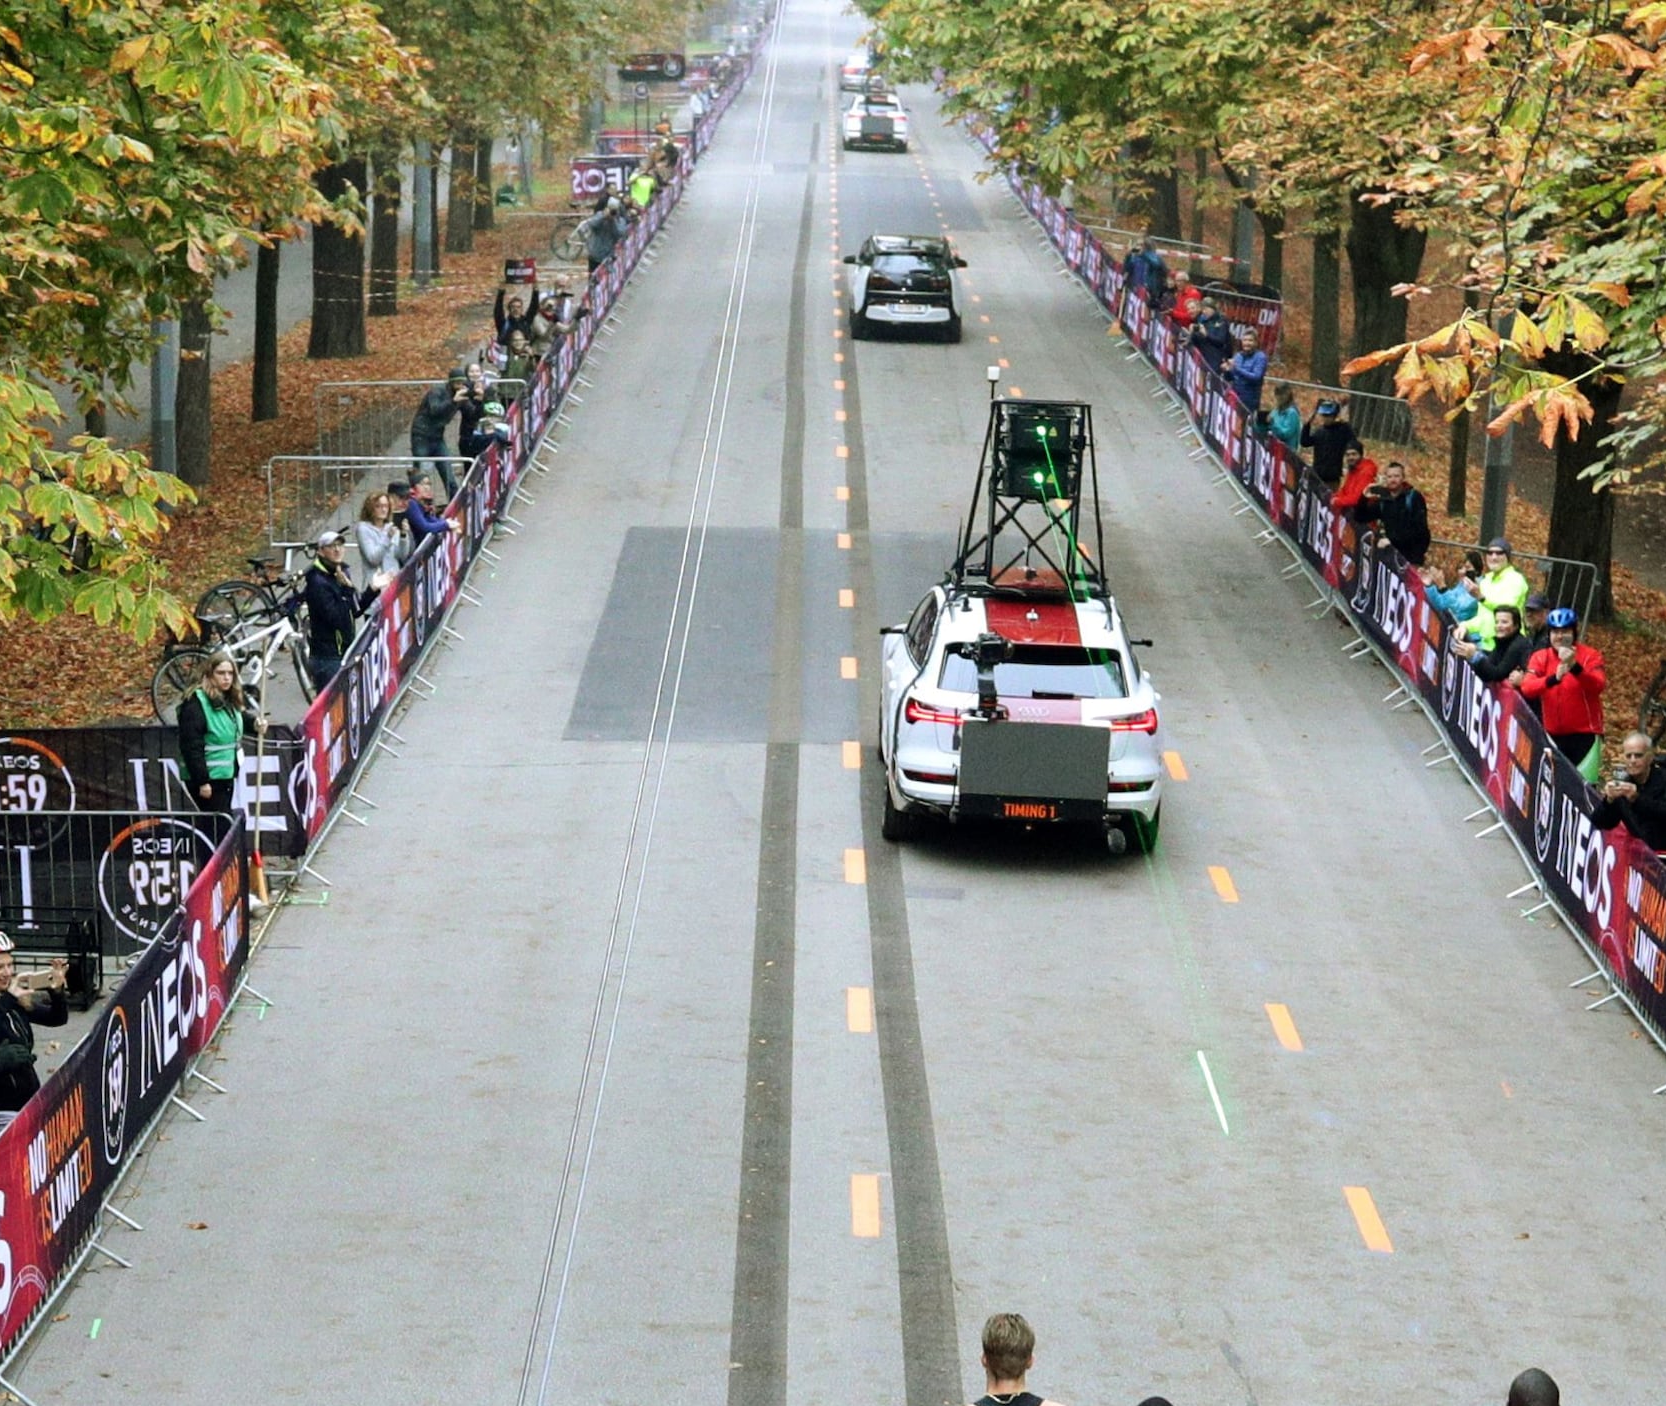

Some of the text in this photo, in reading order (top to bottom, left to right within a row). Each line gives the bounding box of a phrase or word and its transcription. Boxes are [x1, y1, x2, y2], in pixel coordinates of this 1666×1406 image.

[1373, 561, 1416, 652] INEOS
[1457, 659, 1502, 772] INEOS
[1004, 803, 1055, 818] TIMING 1
[1555, 793, 1616, 930] INEOS
[139, 919, 208, 1099] INEOS
[40, 1136, 93, 1246] ISLIMITED
